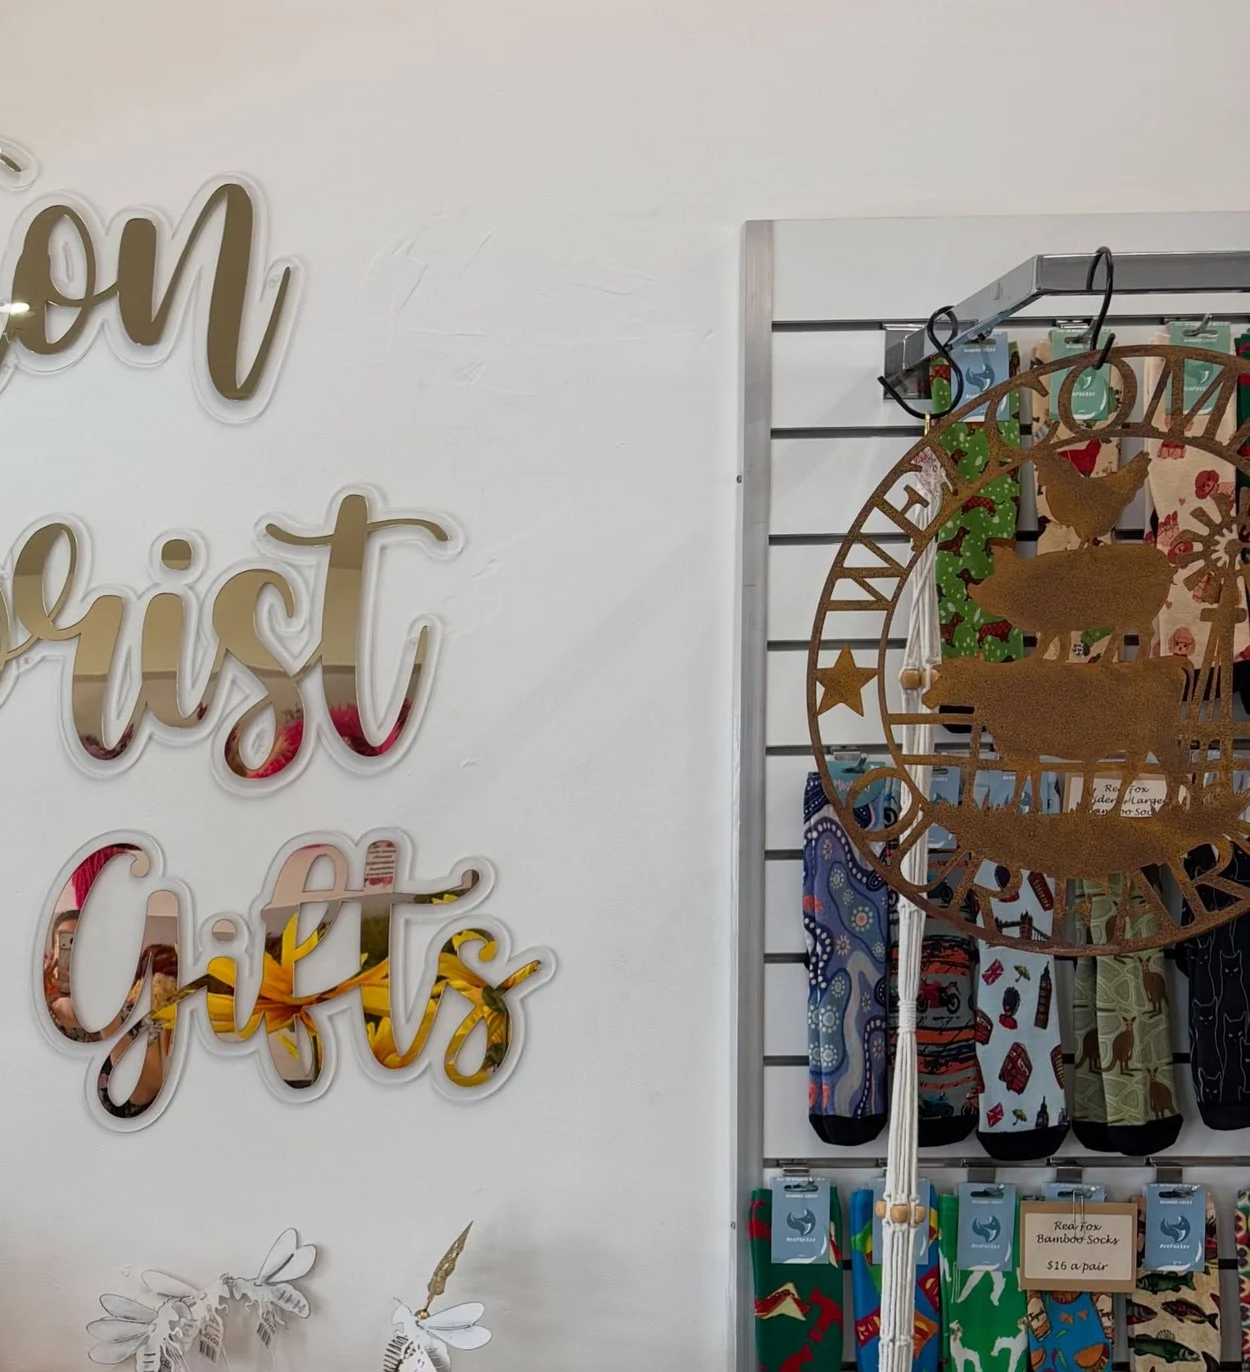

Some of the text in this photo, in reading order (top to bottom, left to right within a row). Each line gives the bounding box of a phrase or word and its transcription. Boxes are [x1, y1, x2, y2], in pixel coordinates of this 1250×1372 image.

[46, 841, 540, 1118] Gifts
[1080, 1221, 1102, 1232] Fox
[1036, 1233, 1120, 1245] Bamboo Socks
[1047, 1260, 1109, 1274] $16 a pair
